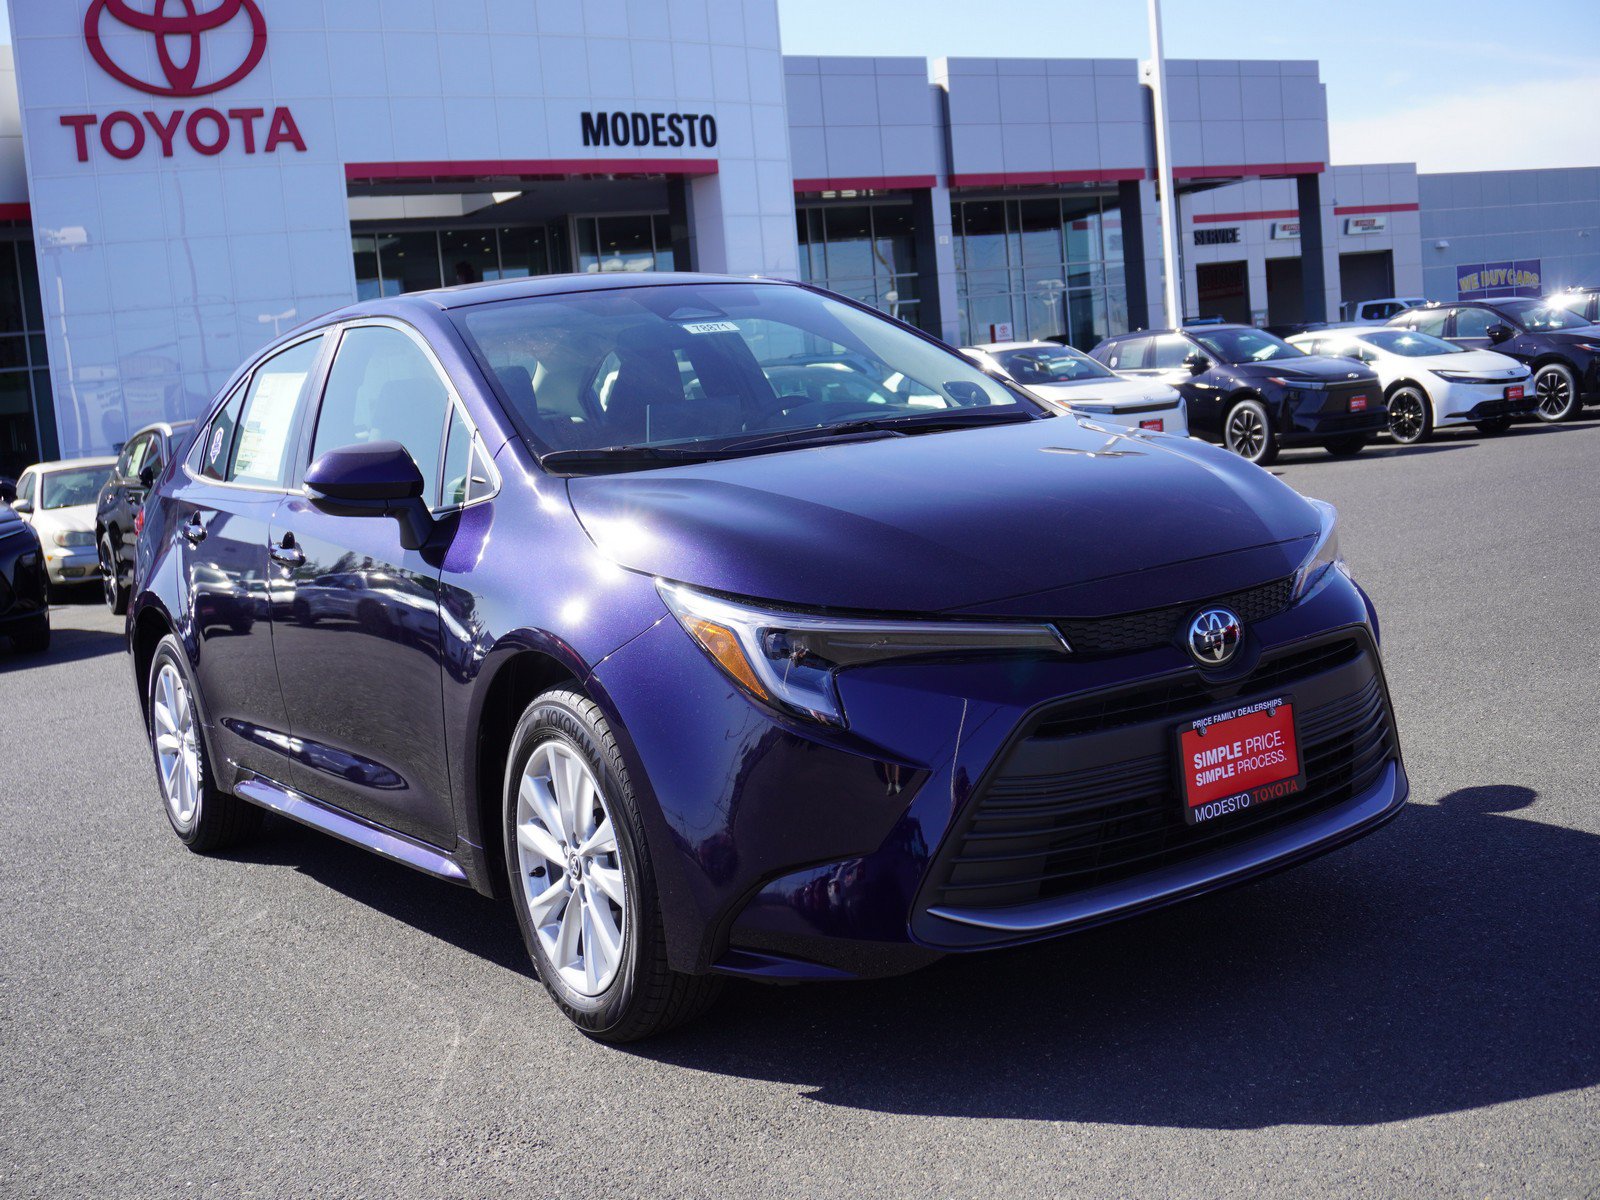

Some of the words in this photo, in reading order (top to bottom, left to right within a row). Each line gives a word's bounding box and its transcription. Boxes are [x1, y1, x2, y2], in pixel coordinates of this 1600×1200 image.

[59, 107, 308, 162] TOYOTA
[580, 111, 718, 148] MODESTO
[1194, 227, 1241, 246] SERVICE
[1459, 272, 1480, 293] WE
[1480, 268, 1508, 287] BUY
[1507, 268, 1540, 290] CARS
[1192, 717, 1213, 730] PRICE
[1213, 709, 1238, 723] FAMILY
[1237, 698, 1283, 717] DEALERSHIPS
[545, 709, 602, 772] YOKOHAMA
[1193, 741, 1243, 770] SIMPLE
[1245, 730, 1285, 755] PRICE.
[1195, 763, 1236, 787] SIMPLE
[1237, 749, 1288, 774] PROCESS.
[1194, 793, 1250, 823] MODESTO
[1253, 779, 1299, 805] TOYOTA
